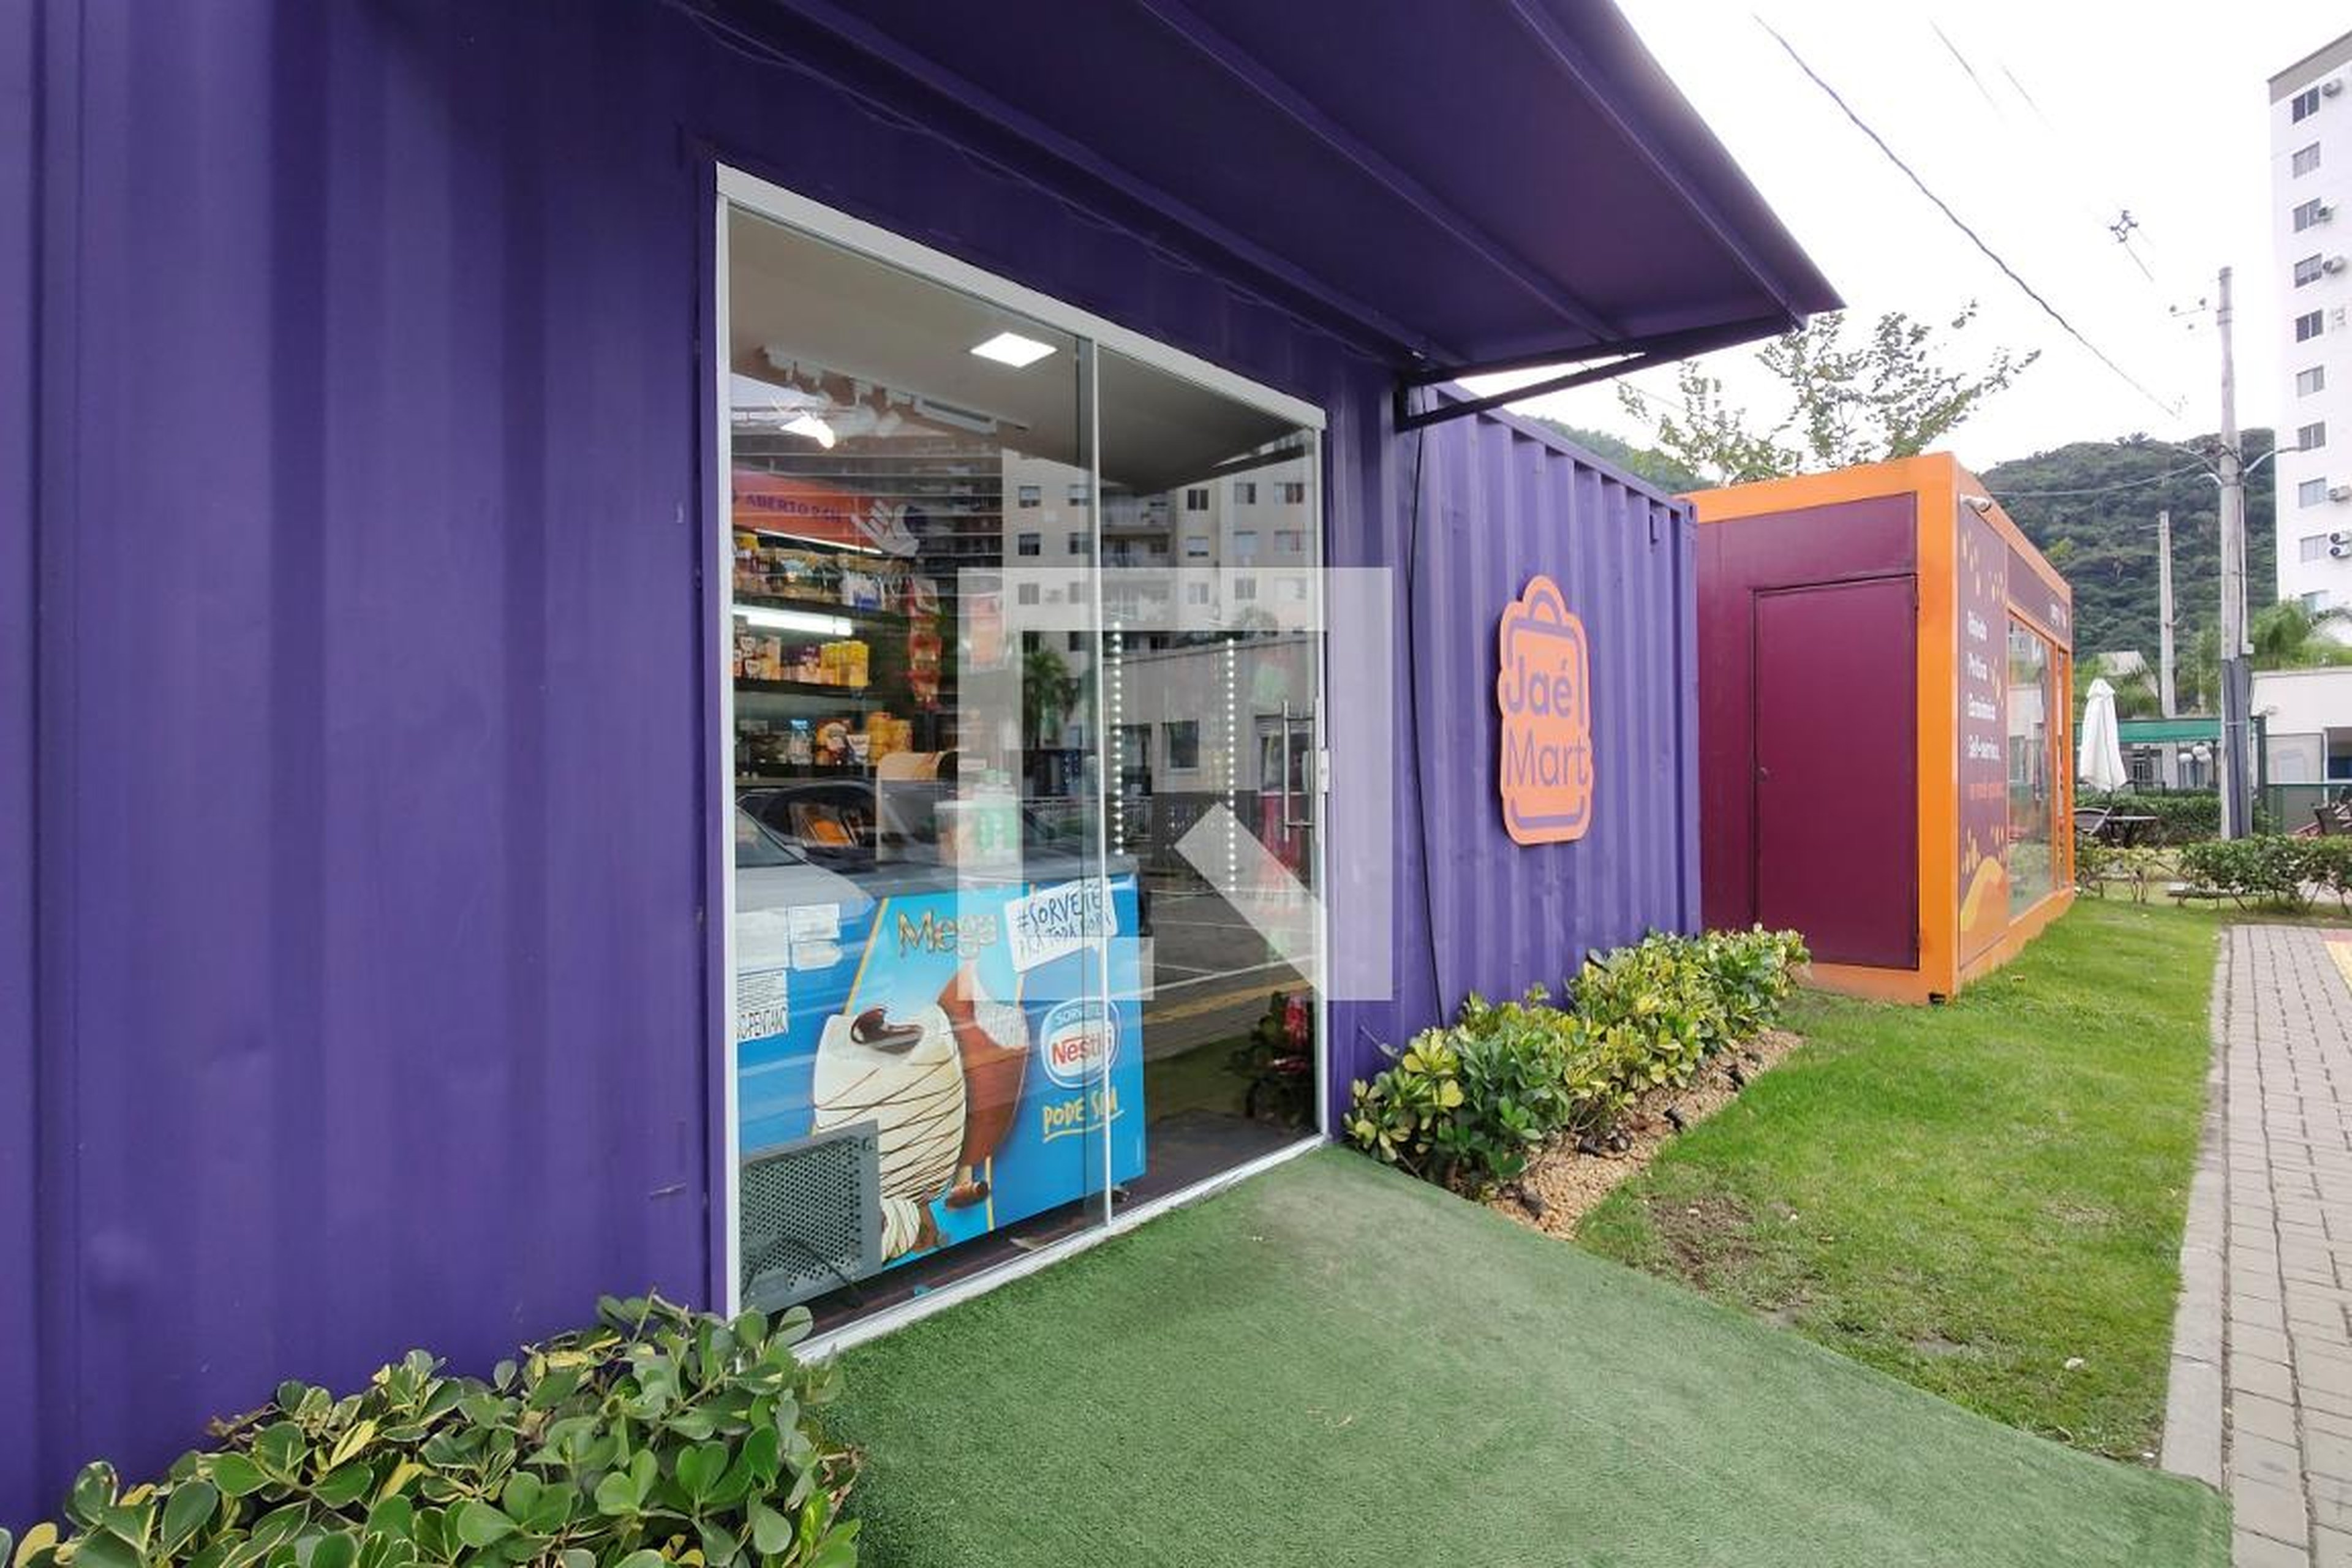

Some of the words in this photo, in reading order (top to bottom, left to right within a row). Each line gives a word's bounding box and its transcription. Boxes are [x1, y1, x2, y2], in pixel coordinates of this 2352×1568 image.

[1505, 655, 1572, 718] Jaé
[1506, 727, 1589, 788] Mart
[897, 909, 998, 959] Mega
[1042, 1097, 1085, 1135] PODE
